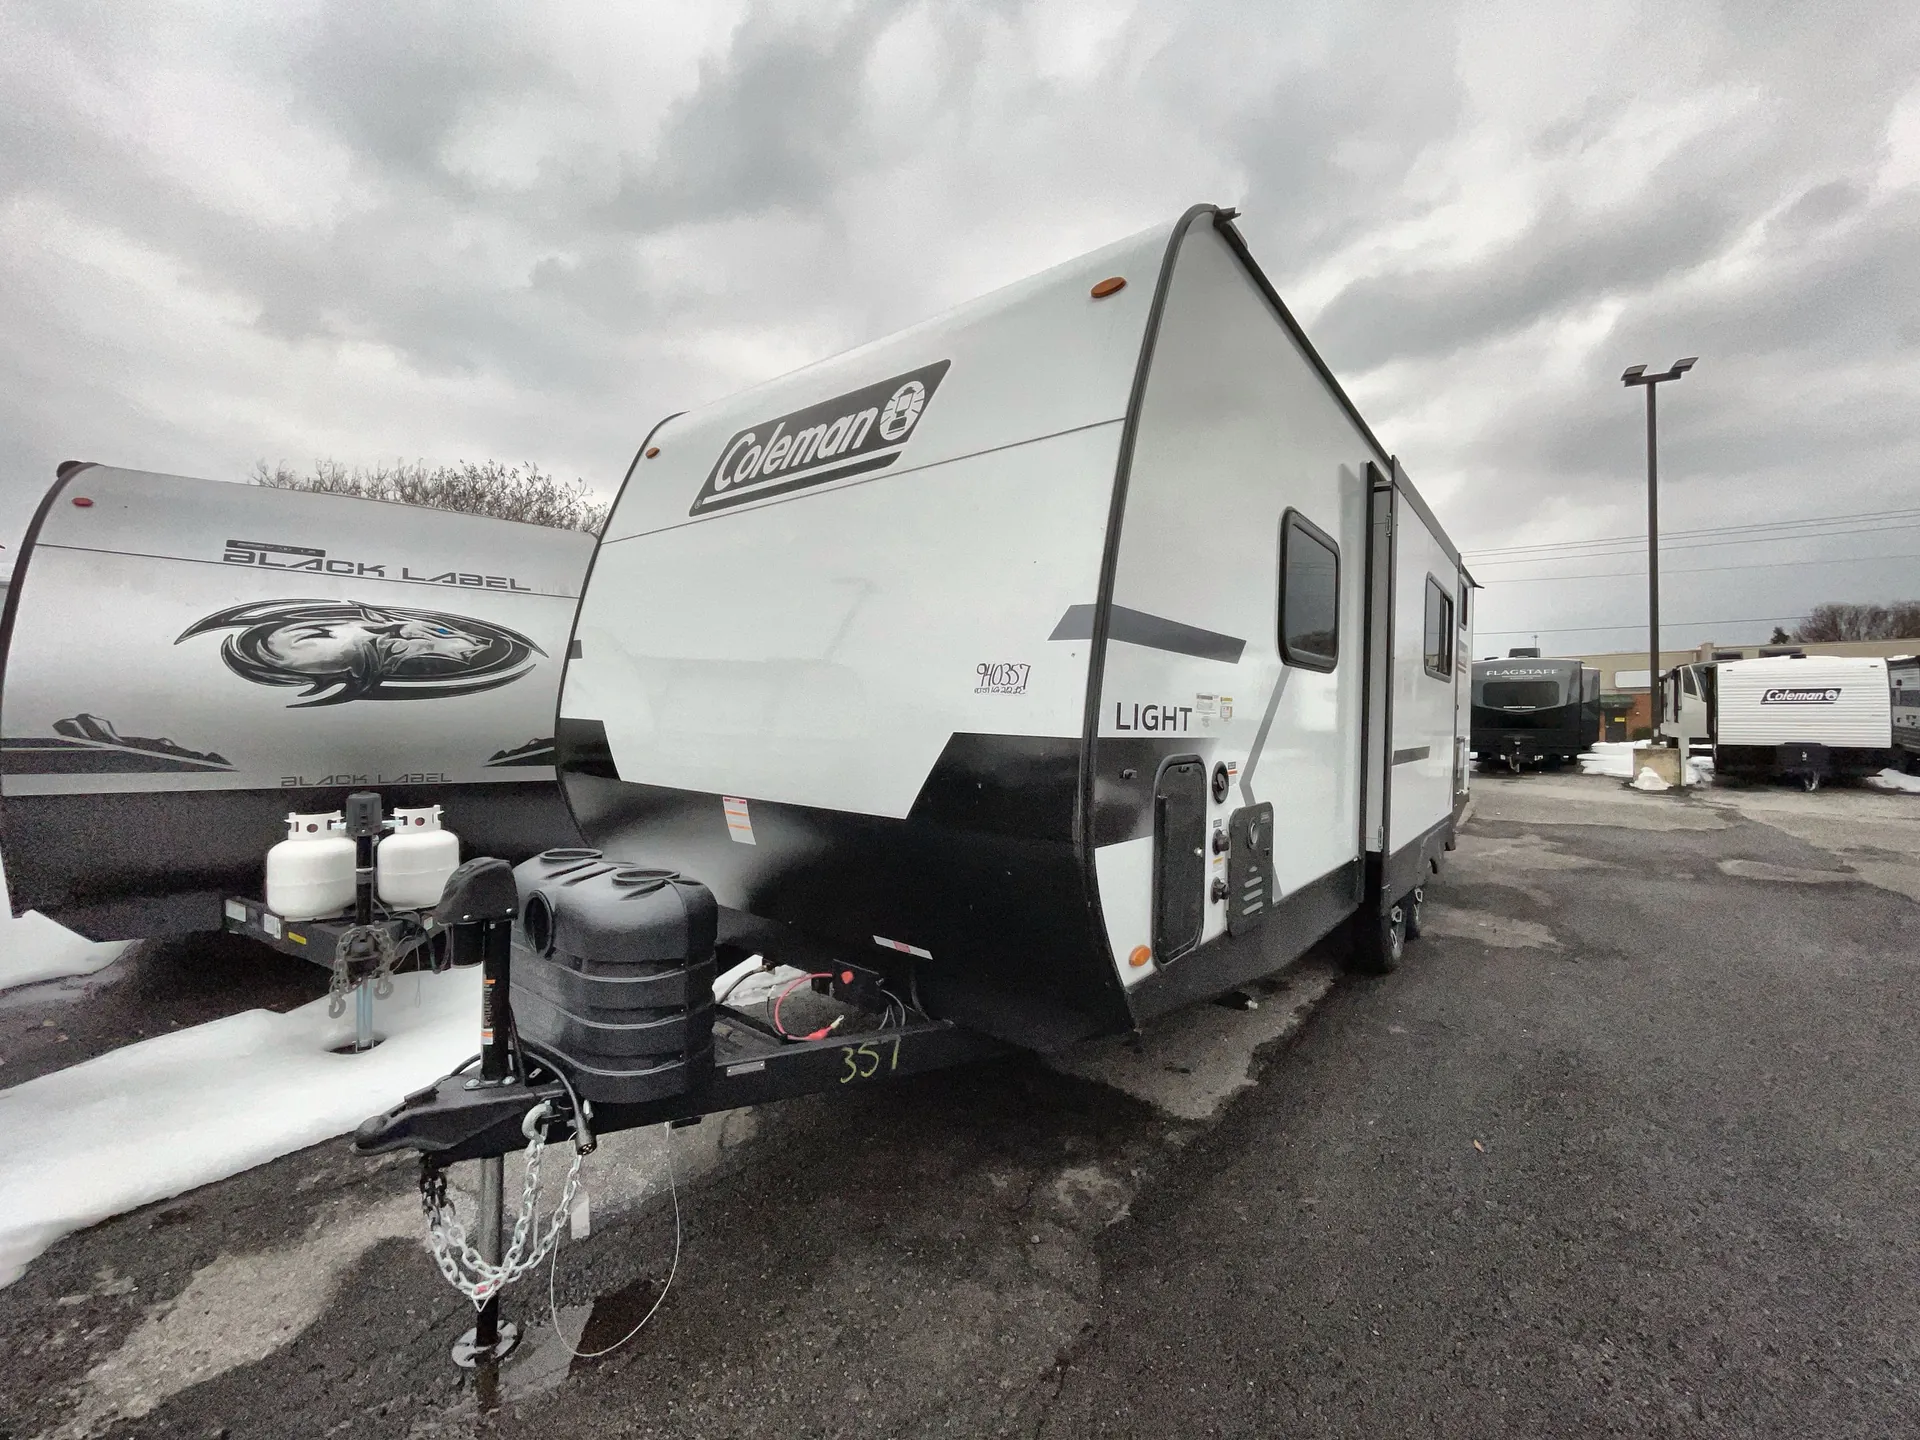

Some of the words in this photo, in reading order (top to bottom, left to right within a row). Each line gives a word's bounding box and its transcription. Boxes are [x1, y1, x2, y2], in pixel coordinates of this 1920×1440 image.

[714, 406, 879, 492] Coleman
[223, 548, 386, 578] BLACK
[402, 567, 531, 591] LABEL
[976, 662, 1031, 690] 940357
[1485, 668, 1559, 676] FLAGSTAFF
[1766, 689, 1824, 701] Coleman
[1116, 702, 1193, 731] LIGHT
[280, 774, 368, 787] BLACK
[378, 772, 453, 784] LABEL
